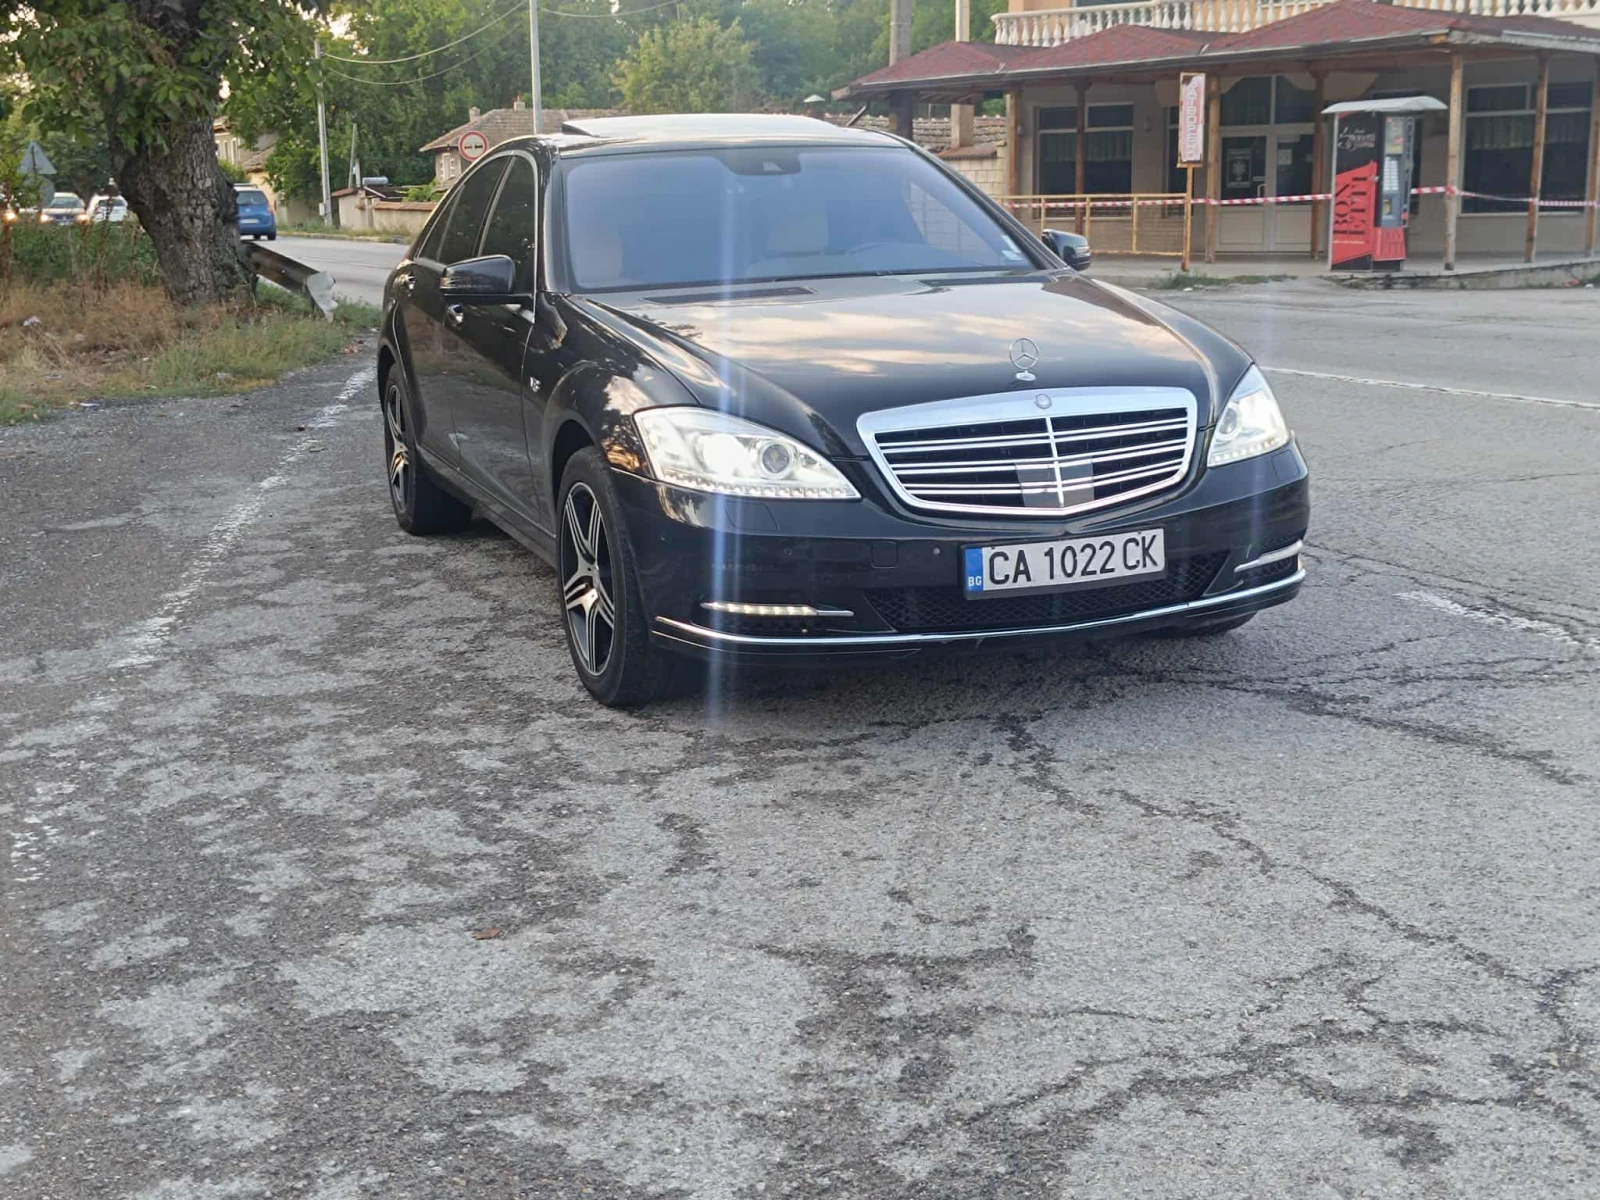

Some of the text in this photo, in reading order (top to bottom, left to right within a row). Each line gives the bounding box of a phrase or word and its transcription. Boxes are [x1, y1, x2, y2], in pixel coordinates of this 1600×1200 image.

[1334, 181, 1350, 235] BON
[1349, 176, 1367, 235] ETTI
[968, 575, 982, 587] BG
[988, 534, 1159, 585] CA 1022 CK
